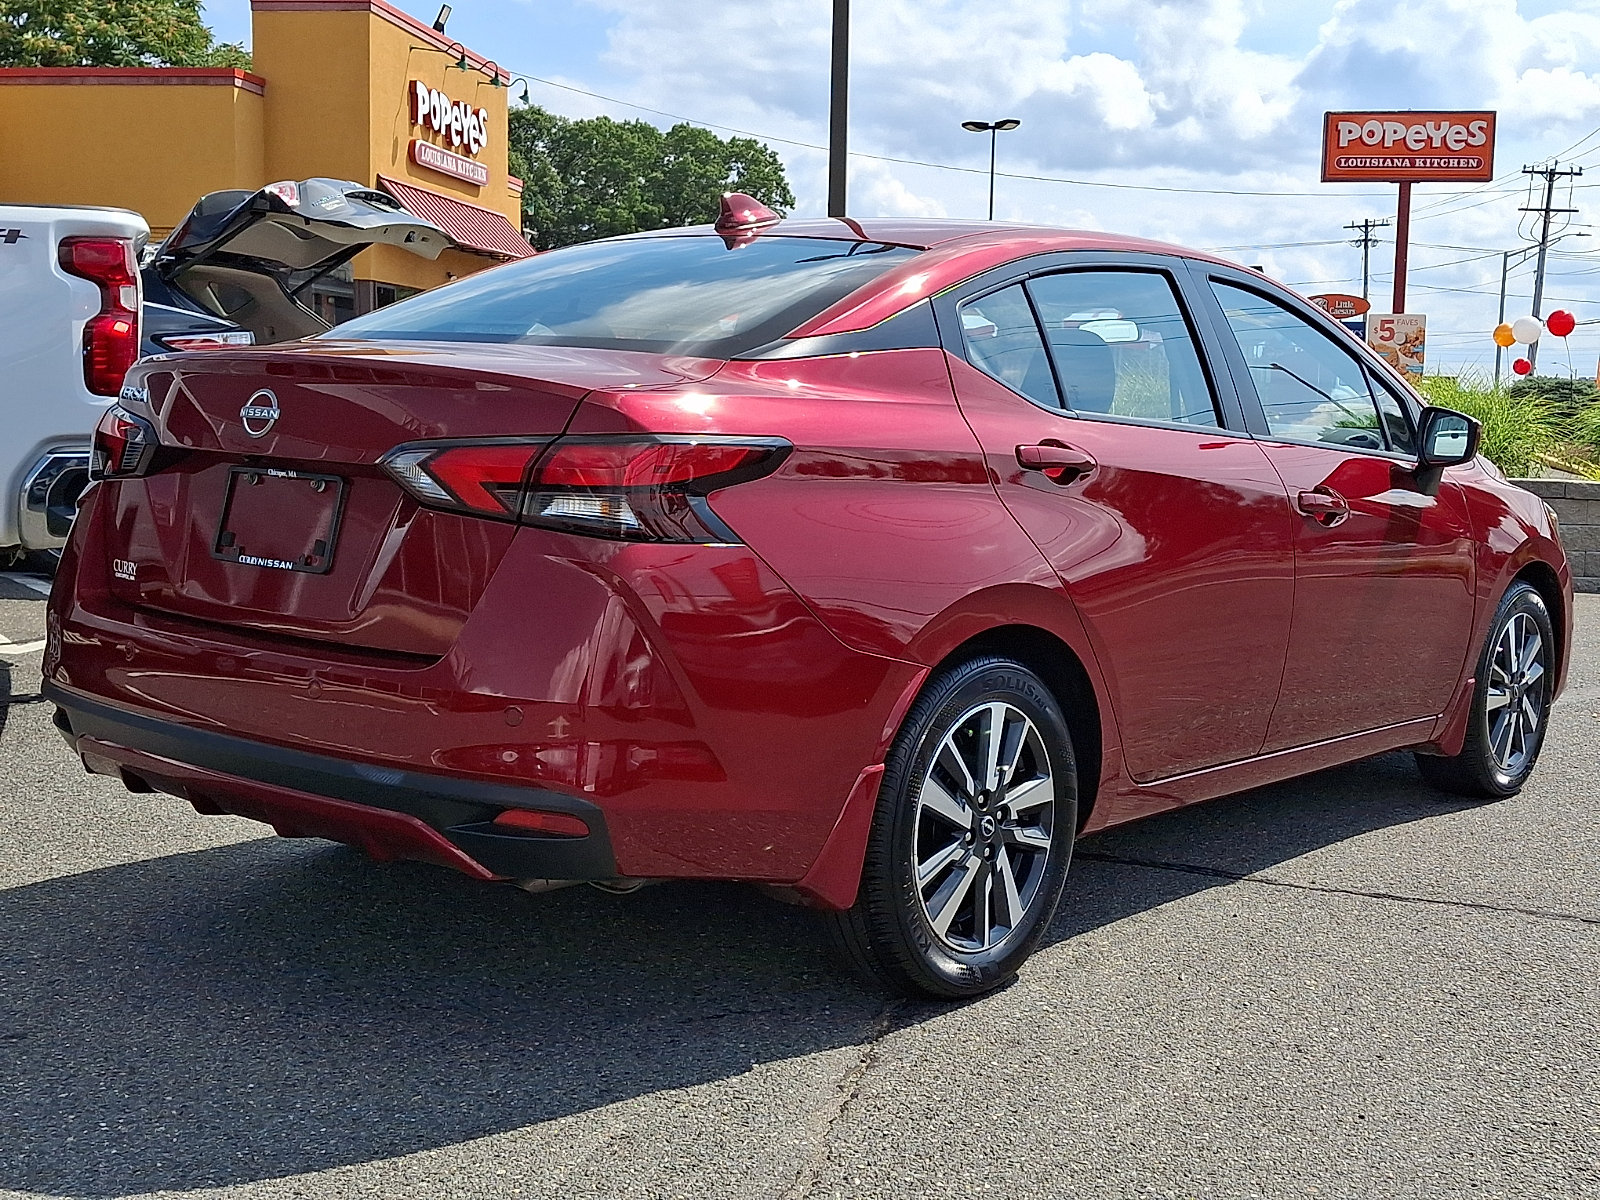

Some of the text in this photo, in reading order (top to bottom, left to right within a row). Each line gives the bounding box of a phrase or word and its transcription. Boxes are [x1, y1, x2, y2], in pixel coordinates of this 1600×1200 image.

[420, 145, 487, 182] LOUISIANA KITCHEN
[1340, 158, 1478, 168] LOUISIANA KITCHEN
[1335, 300, 1355, 309] Little
[1329, 307, 1356, 316] Caesars
[122, 386, 148, 403] ERSA
[242, 408, 279, 418] NISSAN
[113, 558, 138, 575] CURRY
[257, 558, 294, 570] NISSAN
[982, 674, 1037, 698] SOLUS
